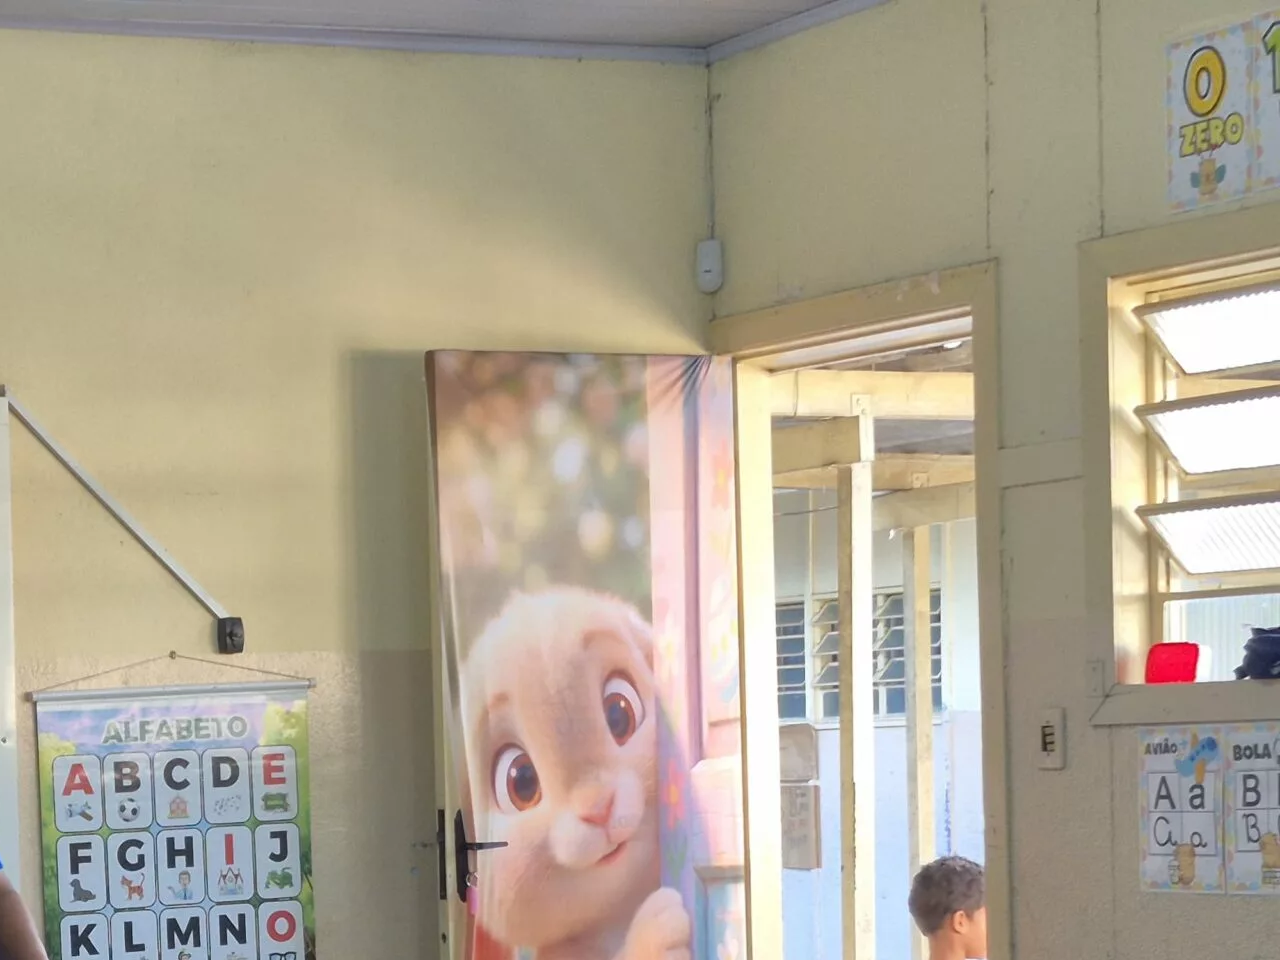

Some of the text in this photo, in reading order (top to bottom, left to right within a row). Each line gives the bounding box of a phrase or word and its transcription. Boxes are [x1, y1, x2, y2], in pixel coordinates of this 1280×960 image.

[1179, 112, 1244, 157] ZERO
[102, 715, 248, 745] ALFABETO
[1144, 738, 1178, 755] AVIÃO
[1233, 743, 1272, 761] BOLA
[62, 753, 286, 796] A B C D E
[1242, 774, 1261, 807] B
[1154, 776, 1205, 809] A a
[69, 831, 288, 874] F G H I J
[70, 910, 296, 956] K L M N O
